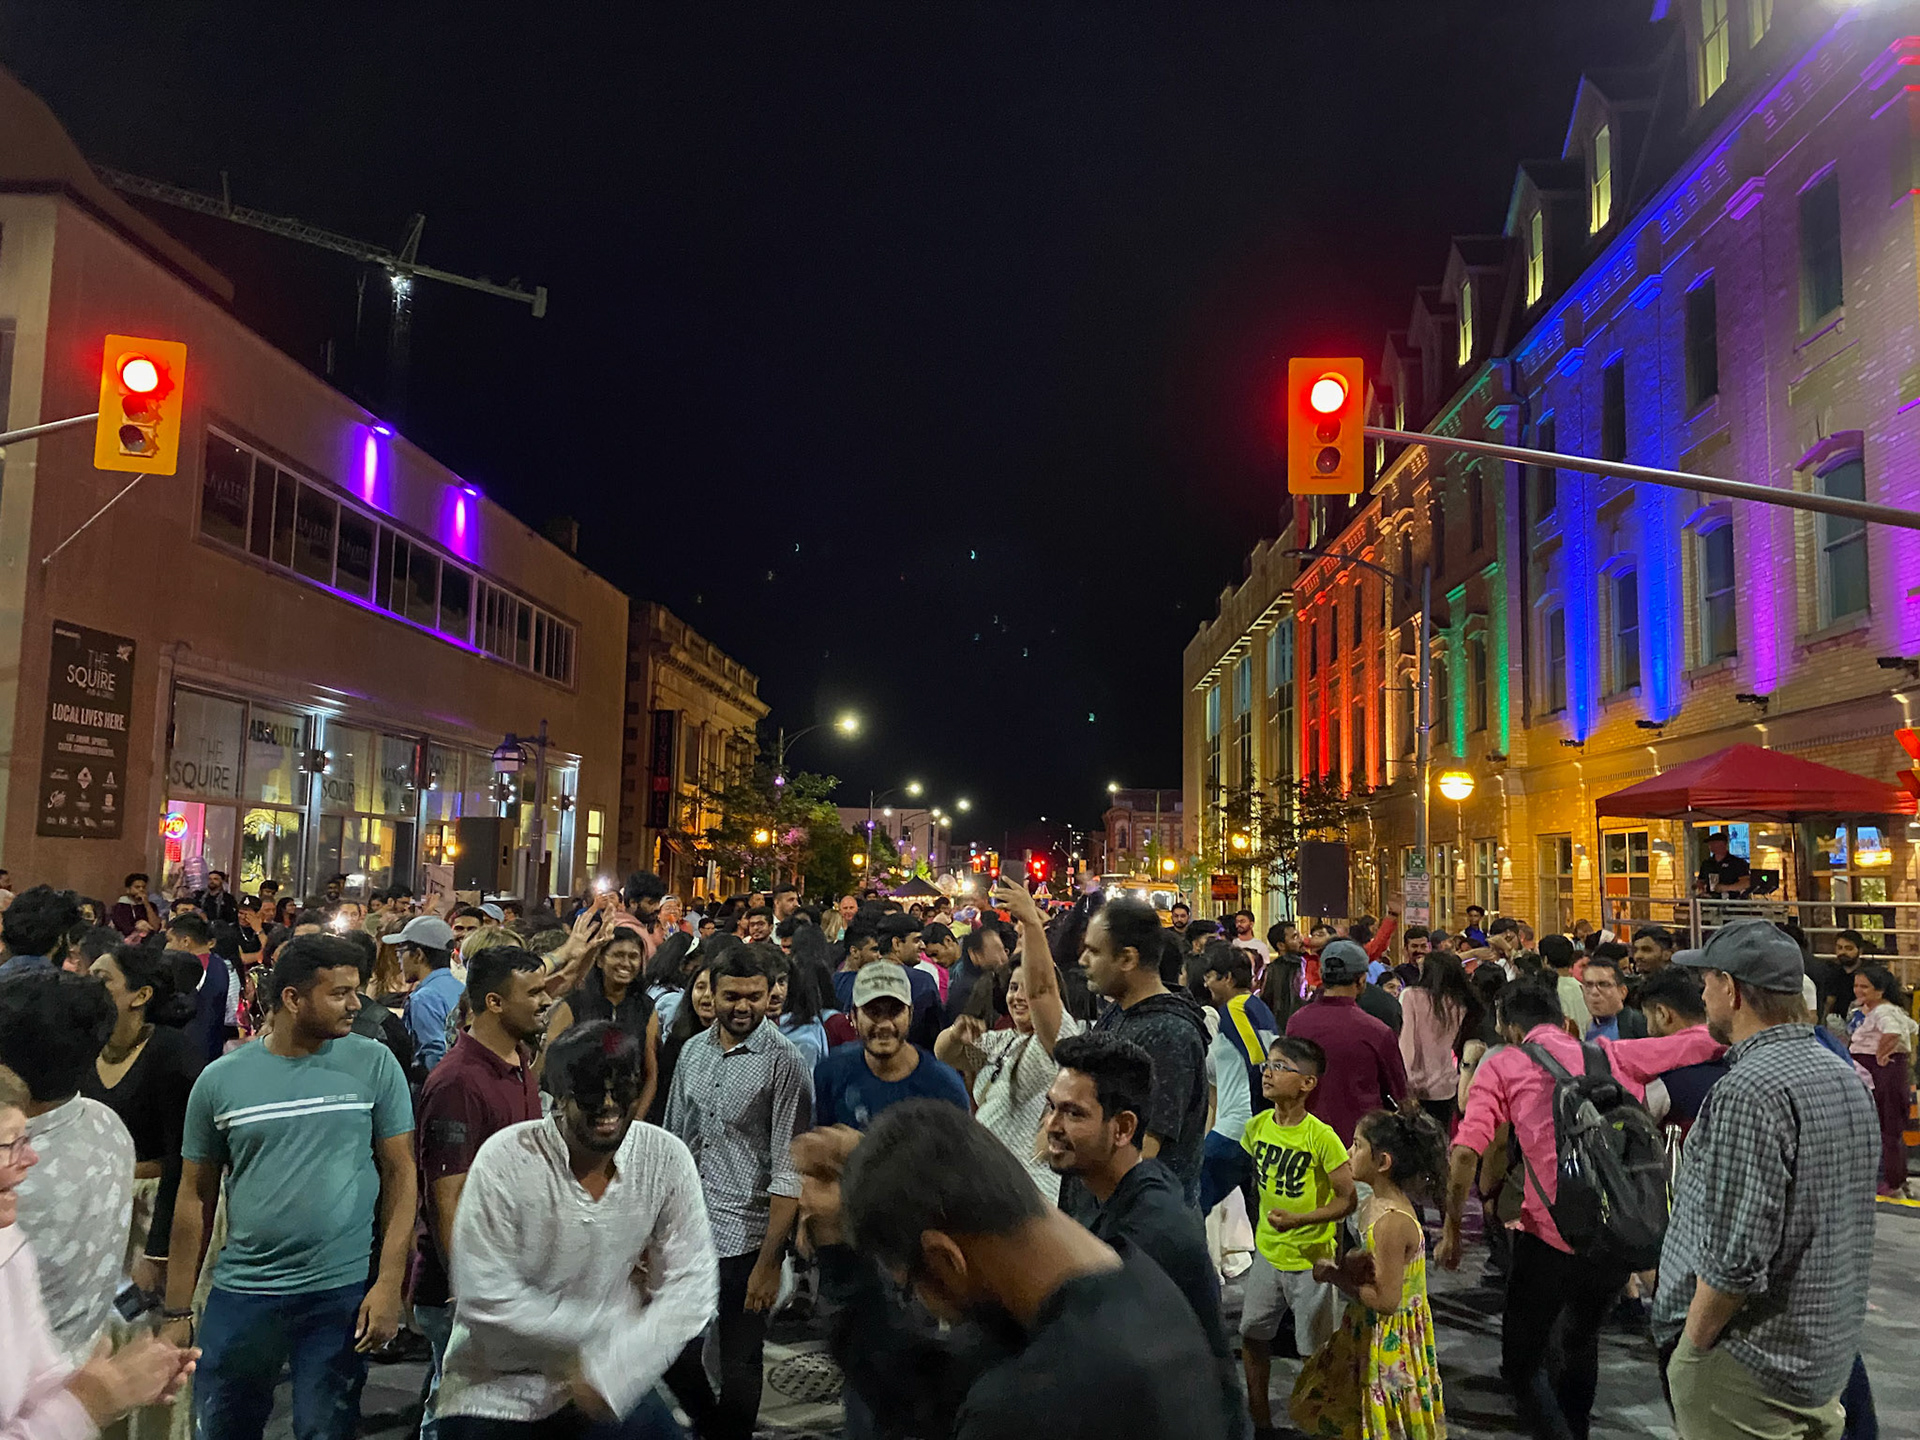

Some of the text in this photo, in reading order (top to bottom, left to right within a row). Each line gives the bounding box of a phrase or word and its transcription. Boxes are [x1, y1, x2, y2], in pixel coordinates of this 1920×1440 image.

[88, 648, 110, 671] THE
[66, 664, 116, 692] SQUIRE
[52, 703, 80, 724] LOCAL
[80, 707, 104, 728] LIVES
[199, 736, 224, 764] THE
[172, 760, 230, 791] SQUIRE
[321, 778, 355, 804] SQUIR
